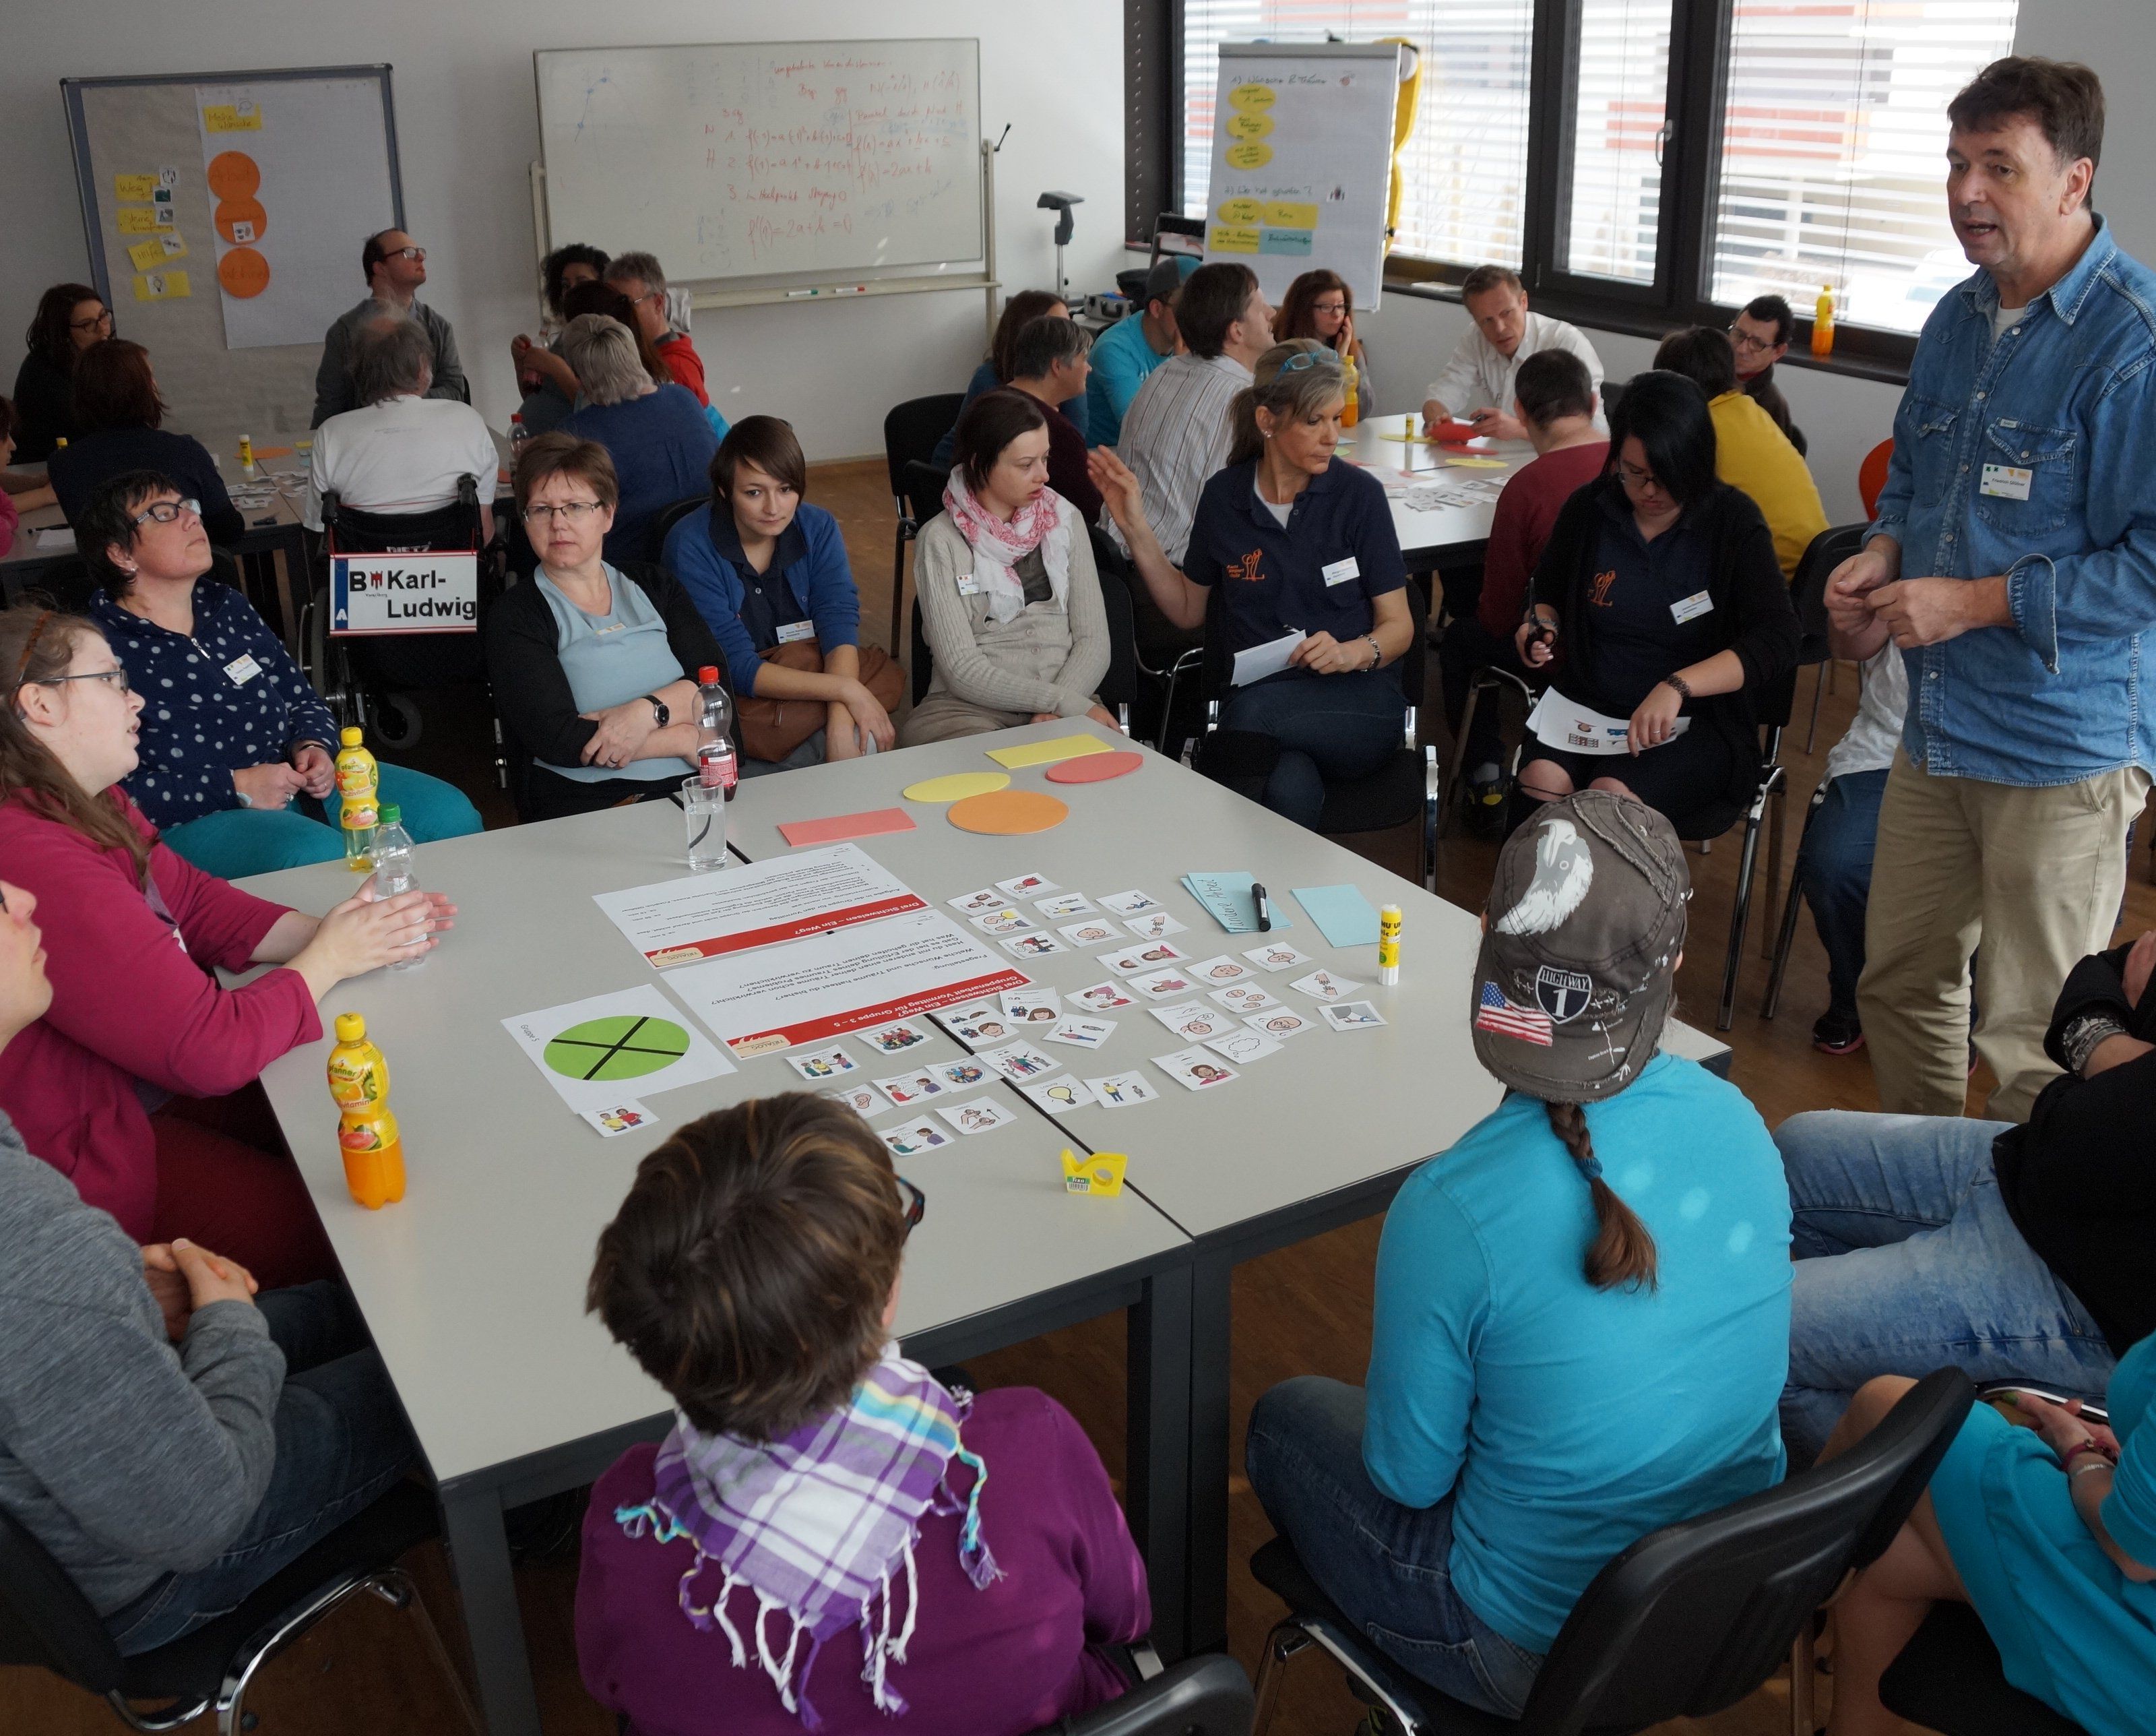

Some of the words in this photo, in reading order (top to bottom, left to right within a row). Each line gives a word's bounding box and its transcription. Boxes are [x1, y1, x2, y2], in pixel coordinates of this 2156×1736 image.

[349, 571, 367, 592] B
[387, 569, 446, 589] Karl-
[387, 597, 476, 620] Ludwig
[336, 609, 348, 621] A
[846, 907, 898, 920] Sichtweisen
[795, 925, 820, 934] Weg?
[872, 944, 906, 955] geholfen
[944, 948, 973, 956] Welche
[842, 954, 869, 963] deinen
[861, 952, 899, 962] Erfüllung
[883, 952, 915, 962] anderen
[904, 956, 942, 966] Wünsche
[934, 954, 986, 968] Fragestellung:
[833, 962, 860, 970] deines
[794, 970, 831, 979] Traumes
[831, 968, 856, 976] deiner
[853, 970, 884, 981] Träume
[740, 972, 799, 988] verwirklichen?
[796, 975, 828, 984] Träume
[822, 980, 851, 988] hattest
[1541, 969, 1588, 990] HIGHWAY
[747, 979, 792, 991] Probleme?
[768, 983, 794, 991] schon
[955, 976, 1016, 994] Gruppenarbeit
[711, 990, 765, 1004] verwirklicht?
[775, 990, 807, 1000] bisher?
[949, 985, 1002, 1000] Sichtweisen
[908, 993, 953, 1006] Vormittag
[1552, 989, 1567, 1018] 1
[858, 1010, 891, 1020] Gruppe
[898, 1007, 924, 1016] Weg?
